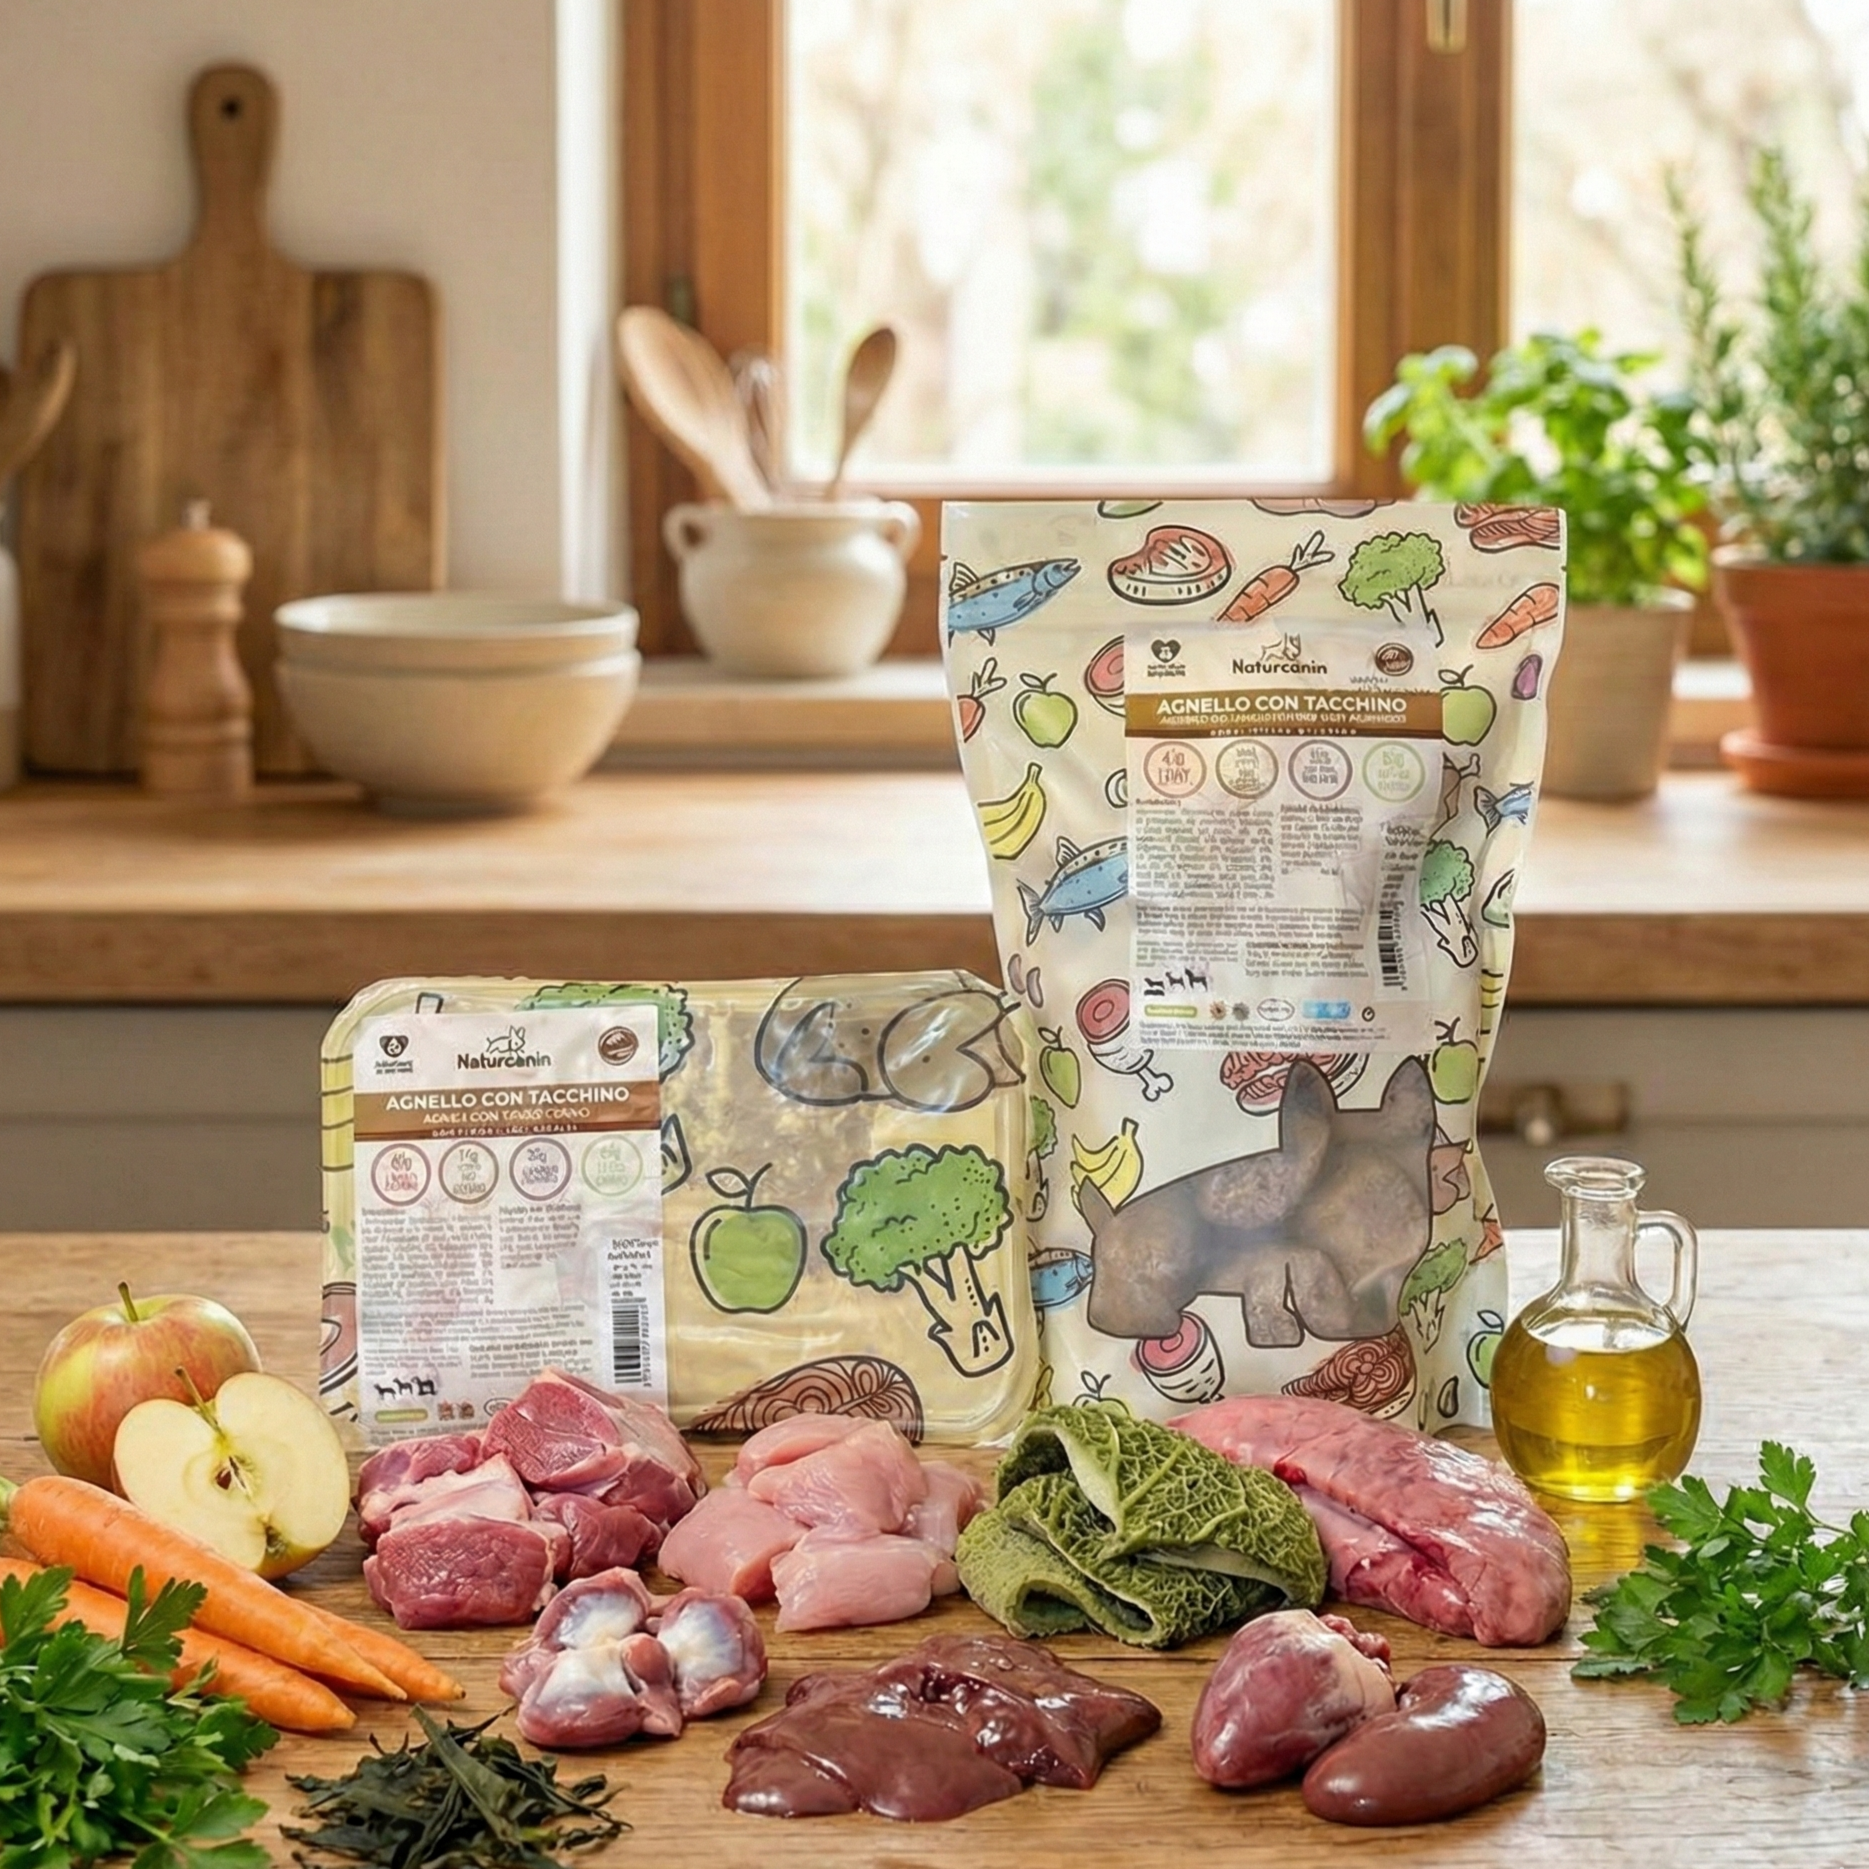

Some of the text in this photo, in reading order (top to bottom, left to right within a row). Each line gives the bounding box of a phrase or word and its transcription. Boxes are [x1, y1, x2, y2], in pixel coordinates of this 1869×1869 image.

[1231, 659, 1328, 676] Naturcanin
[1156, 695, 1407, 715] AGNELLO CON TACCHINO
[385, 1086, 630, 1111] AGNELLO CON TACCHINO
